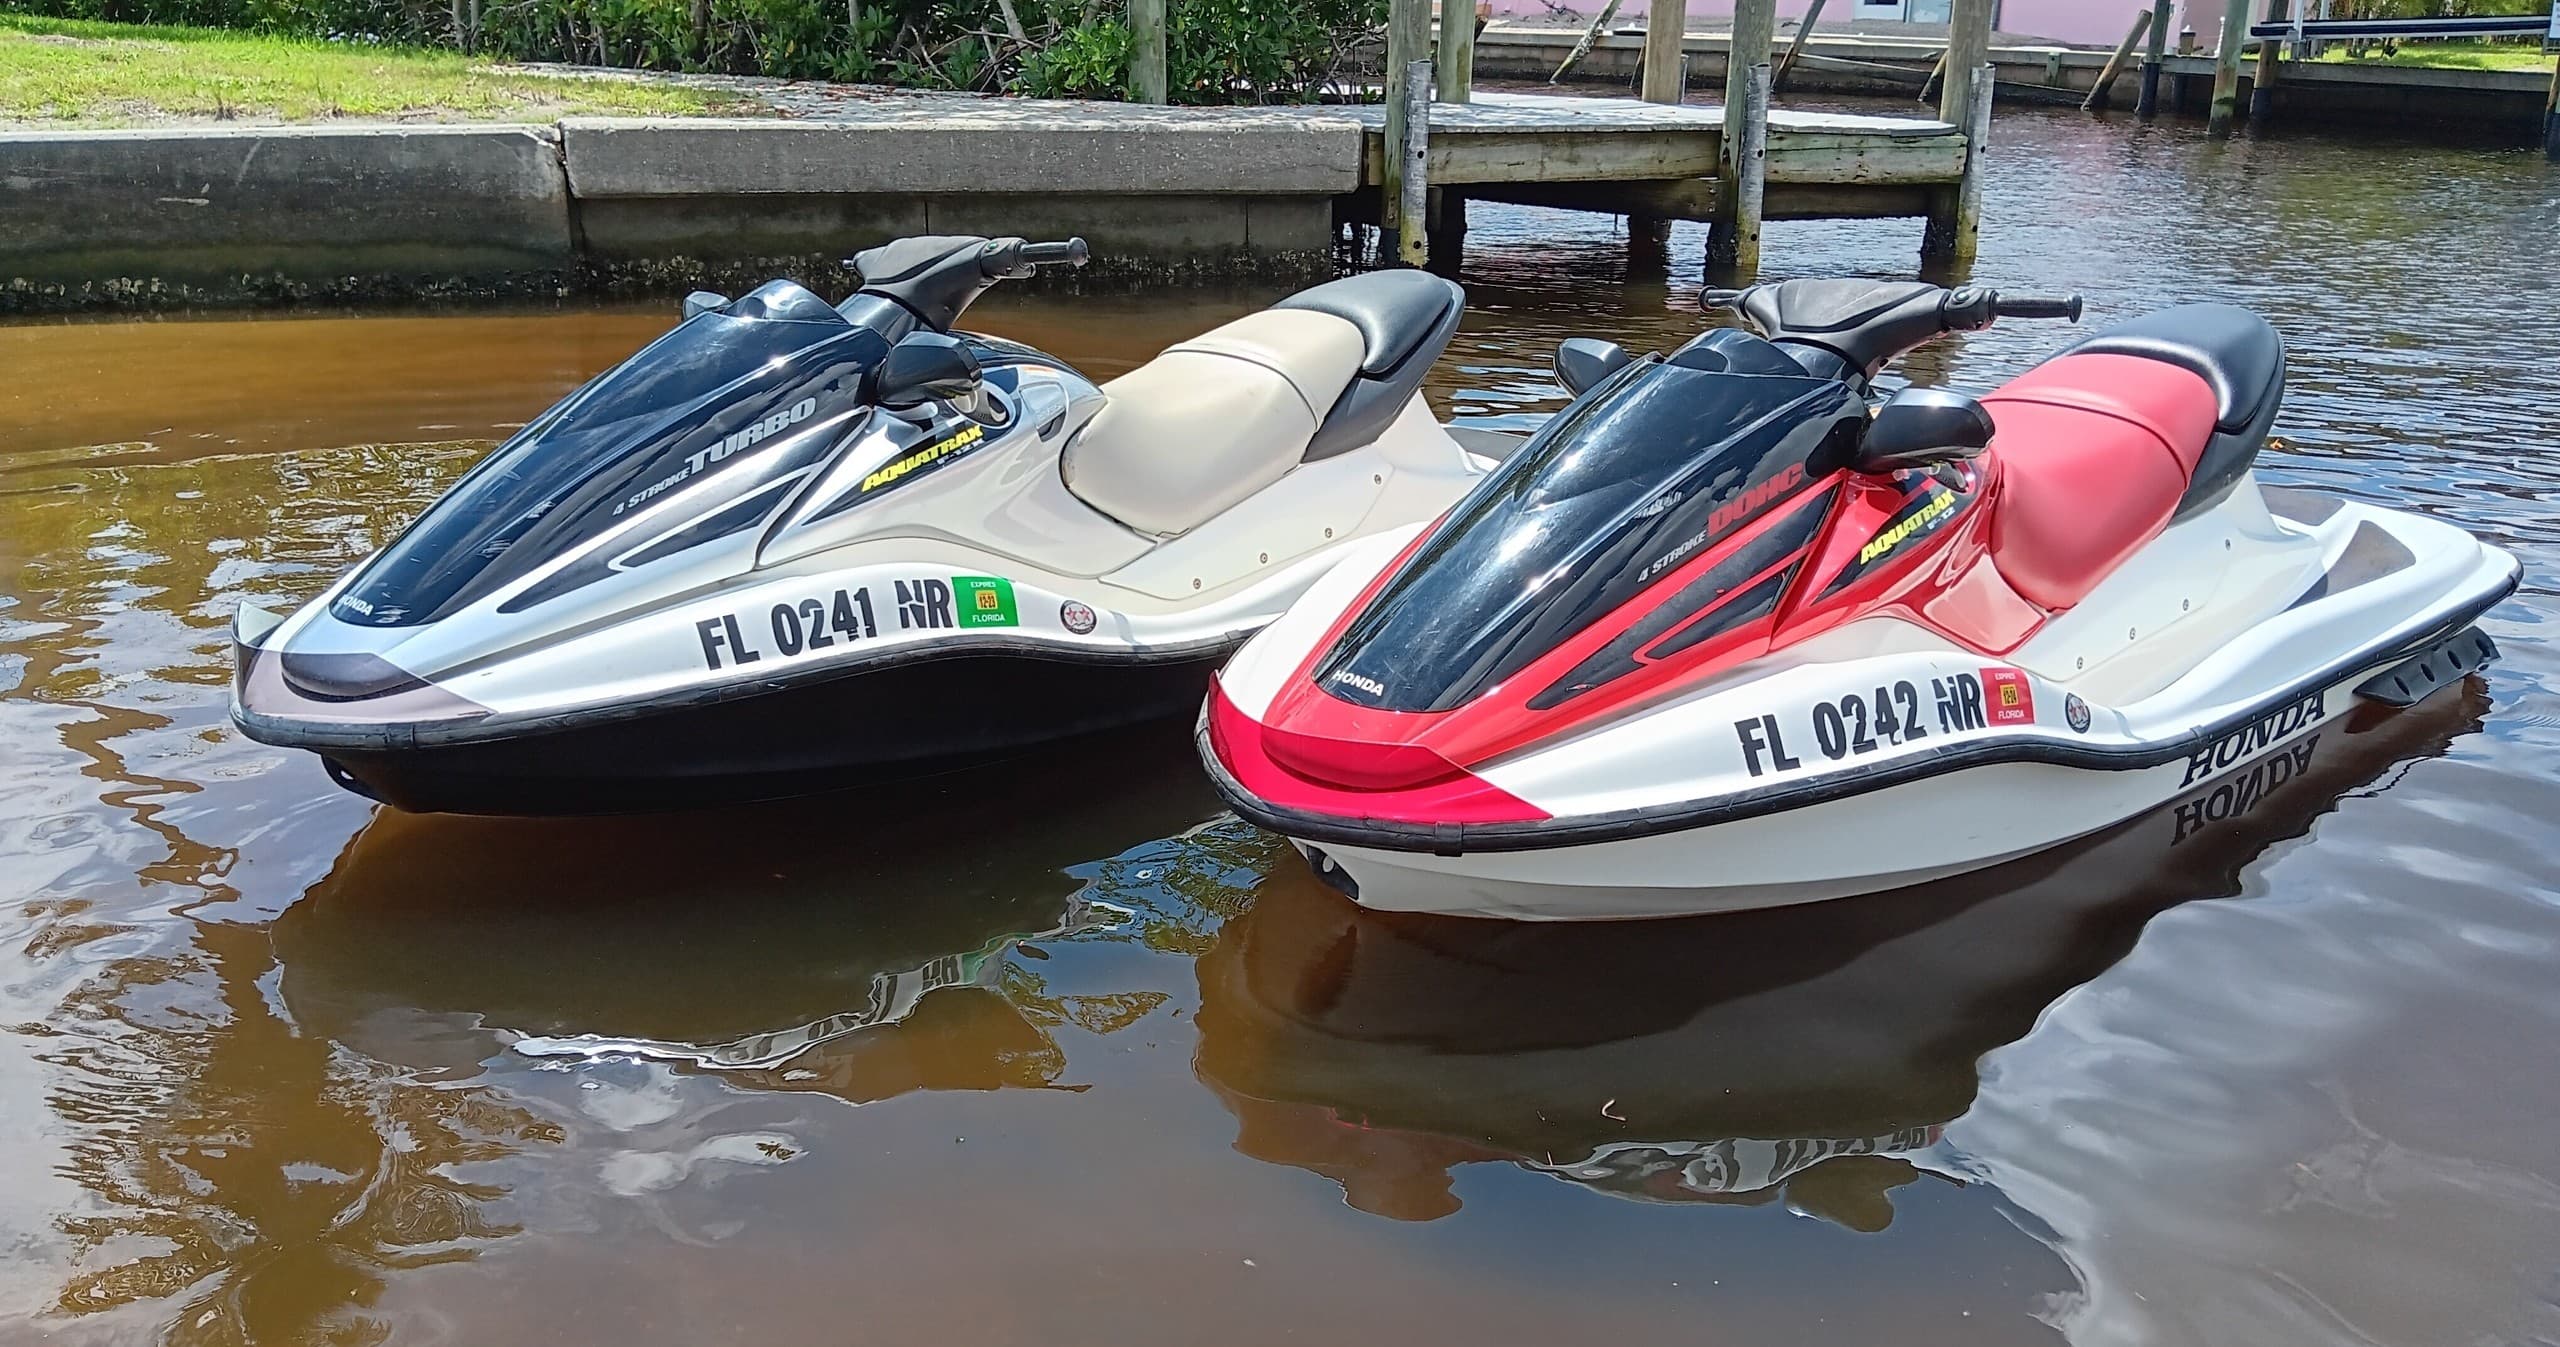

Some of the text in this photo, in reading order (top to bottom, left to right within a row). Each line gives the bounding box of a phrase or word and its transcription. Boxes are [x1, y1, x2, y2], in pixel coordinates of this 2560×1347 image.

[612, 397, 817, 516] 4 STROKE TURBO
[861, 424, 983, 492] AQUATRAX
[1637, 462, 1804, 583] 4 STROKE DOHC
[1860, 488, 1956, 565] AQUATRAX
[695, 579, 954, 671] FL 0241 NR
[972, 614, 1005, 622] FLORIDA
[1331, 669, 1385, 697] HONDA
[1734, 672, 1986, 777] FL 0242 NR
[1998, 710, 2024, 720] FLORIDA
[2179, 690, 2326, 790] HONDA
